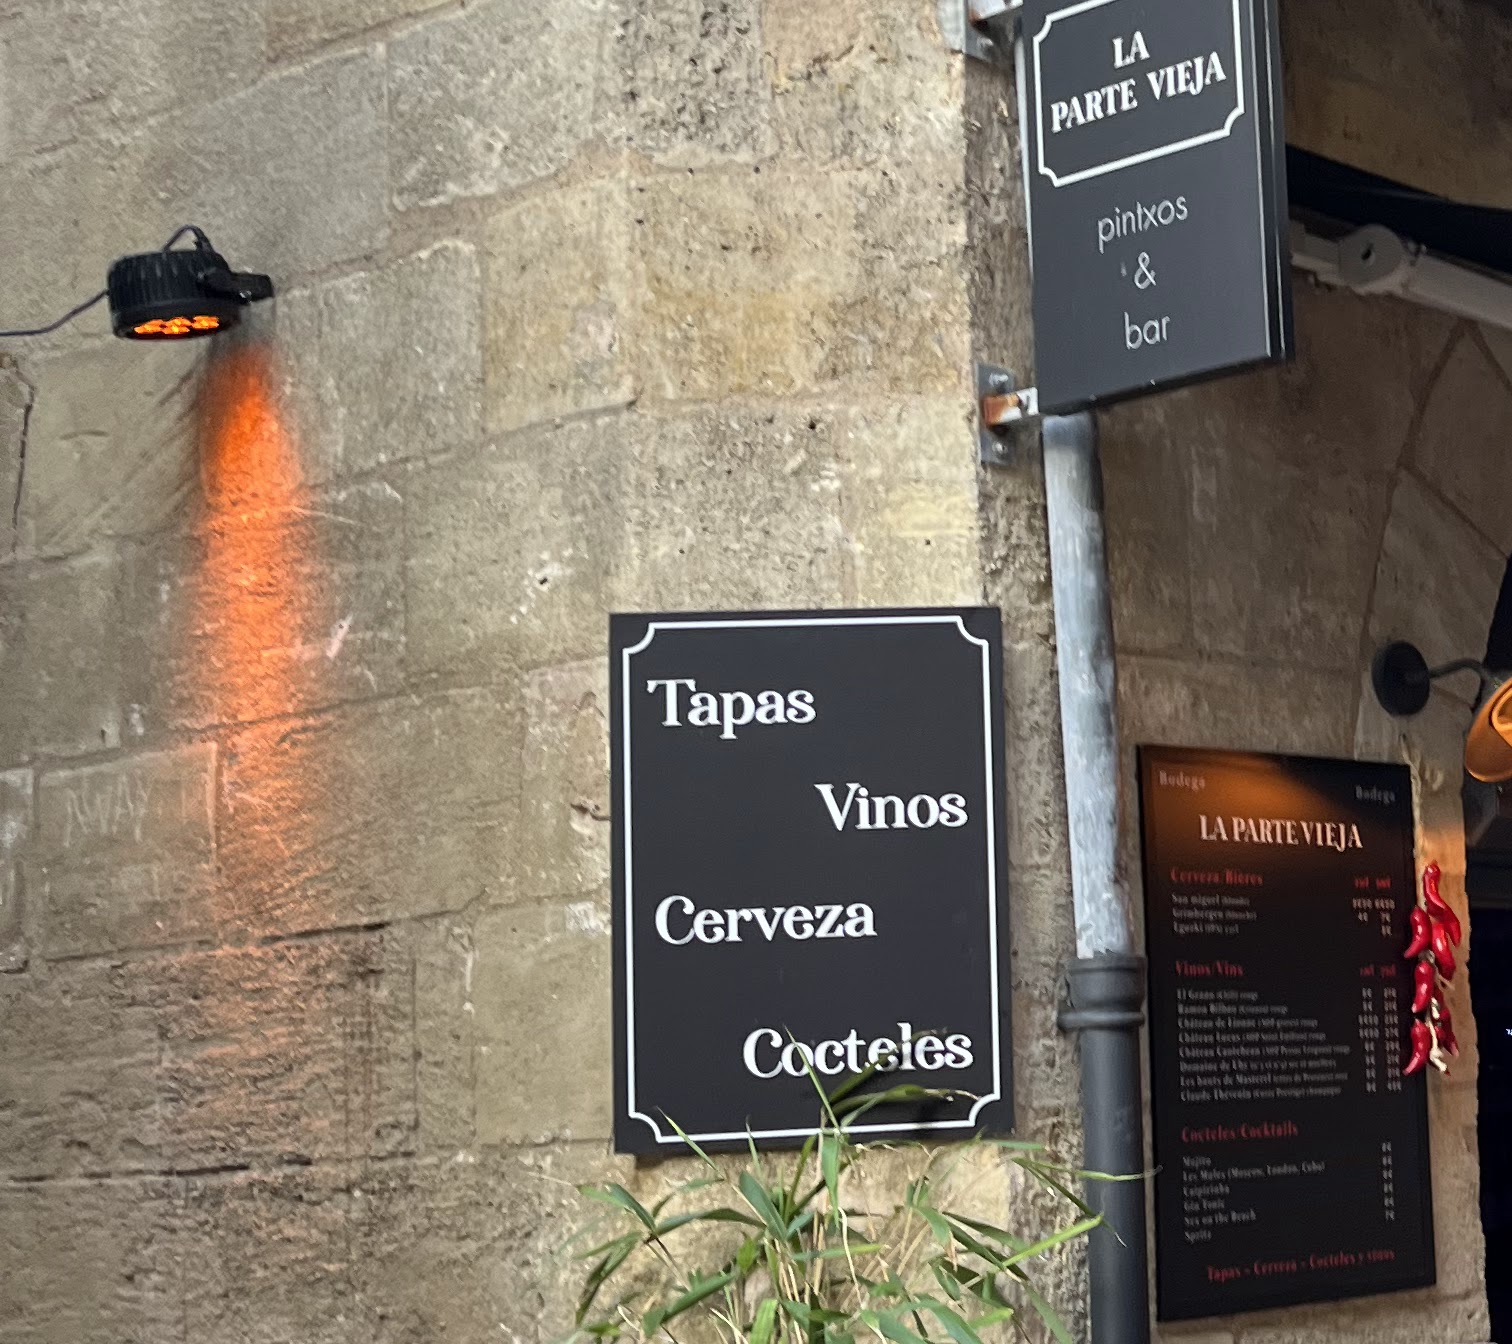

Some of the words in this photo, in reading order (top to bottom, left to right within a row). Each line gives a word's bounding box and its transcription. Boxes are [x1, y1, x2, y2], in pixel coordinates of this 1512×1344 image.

[1112, 30, 1150, 69] LA
[1050, 78, 1138, 133] PARTE
[1146, 51, 1227, 100] VIEJA
[1097, 194, 1189, 254] pintxos
[1133, 251, 1157, 290] &
[1122, 310, 1172, 351] bar
[647, 678, 818, 740] Tapas
[814, 782, 969, 831] Vinos
[1199, 814, 1229, 842] LA
[1232, 815, 1299, 846] PARTE
[1299, 821, 1363, 852] VIEJA
[655, 895, 878, 945] Cerveza
[743, 1023, 974, 1079] Cocteles
